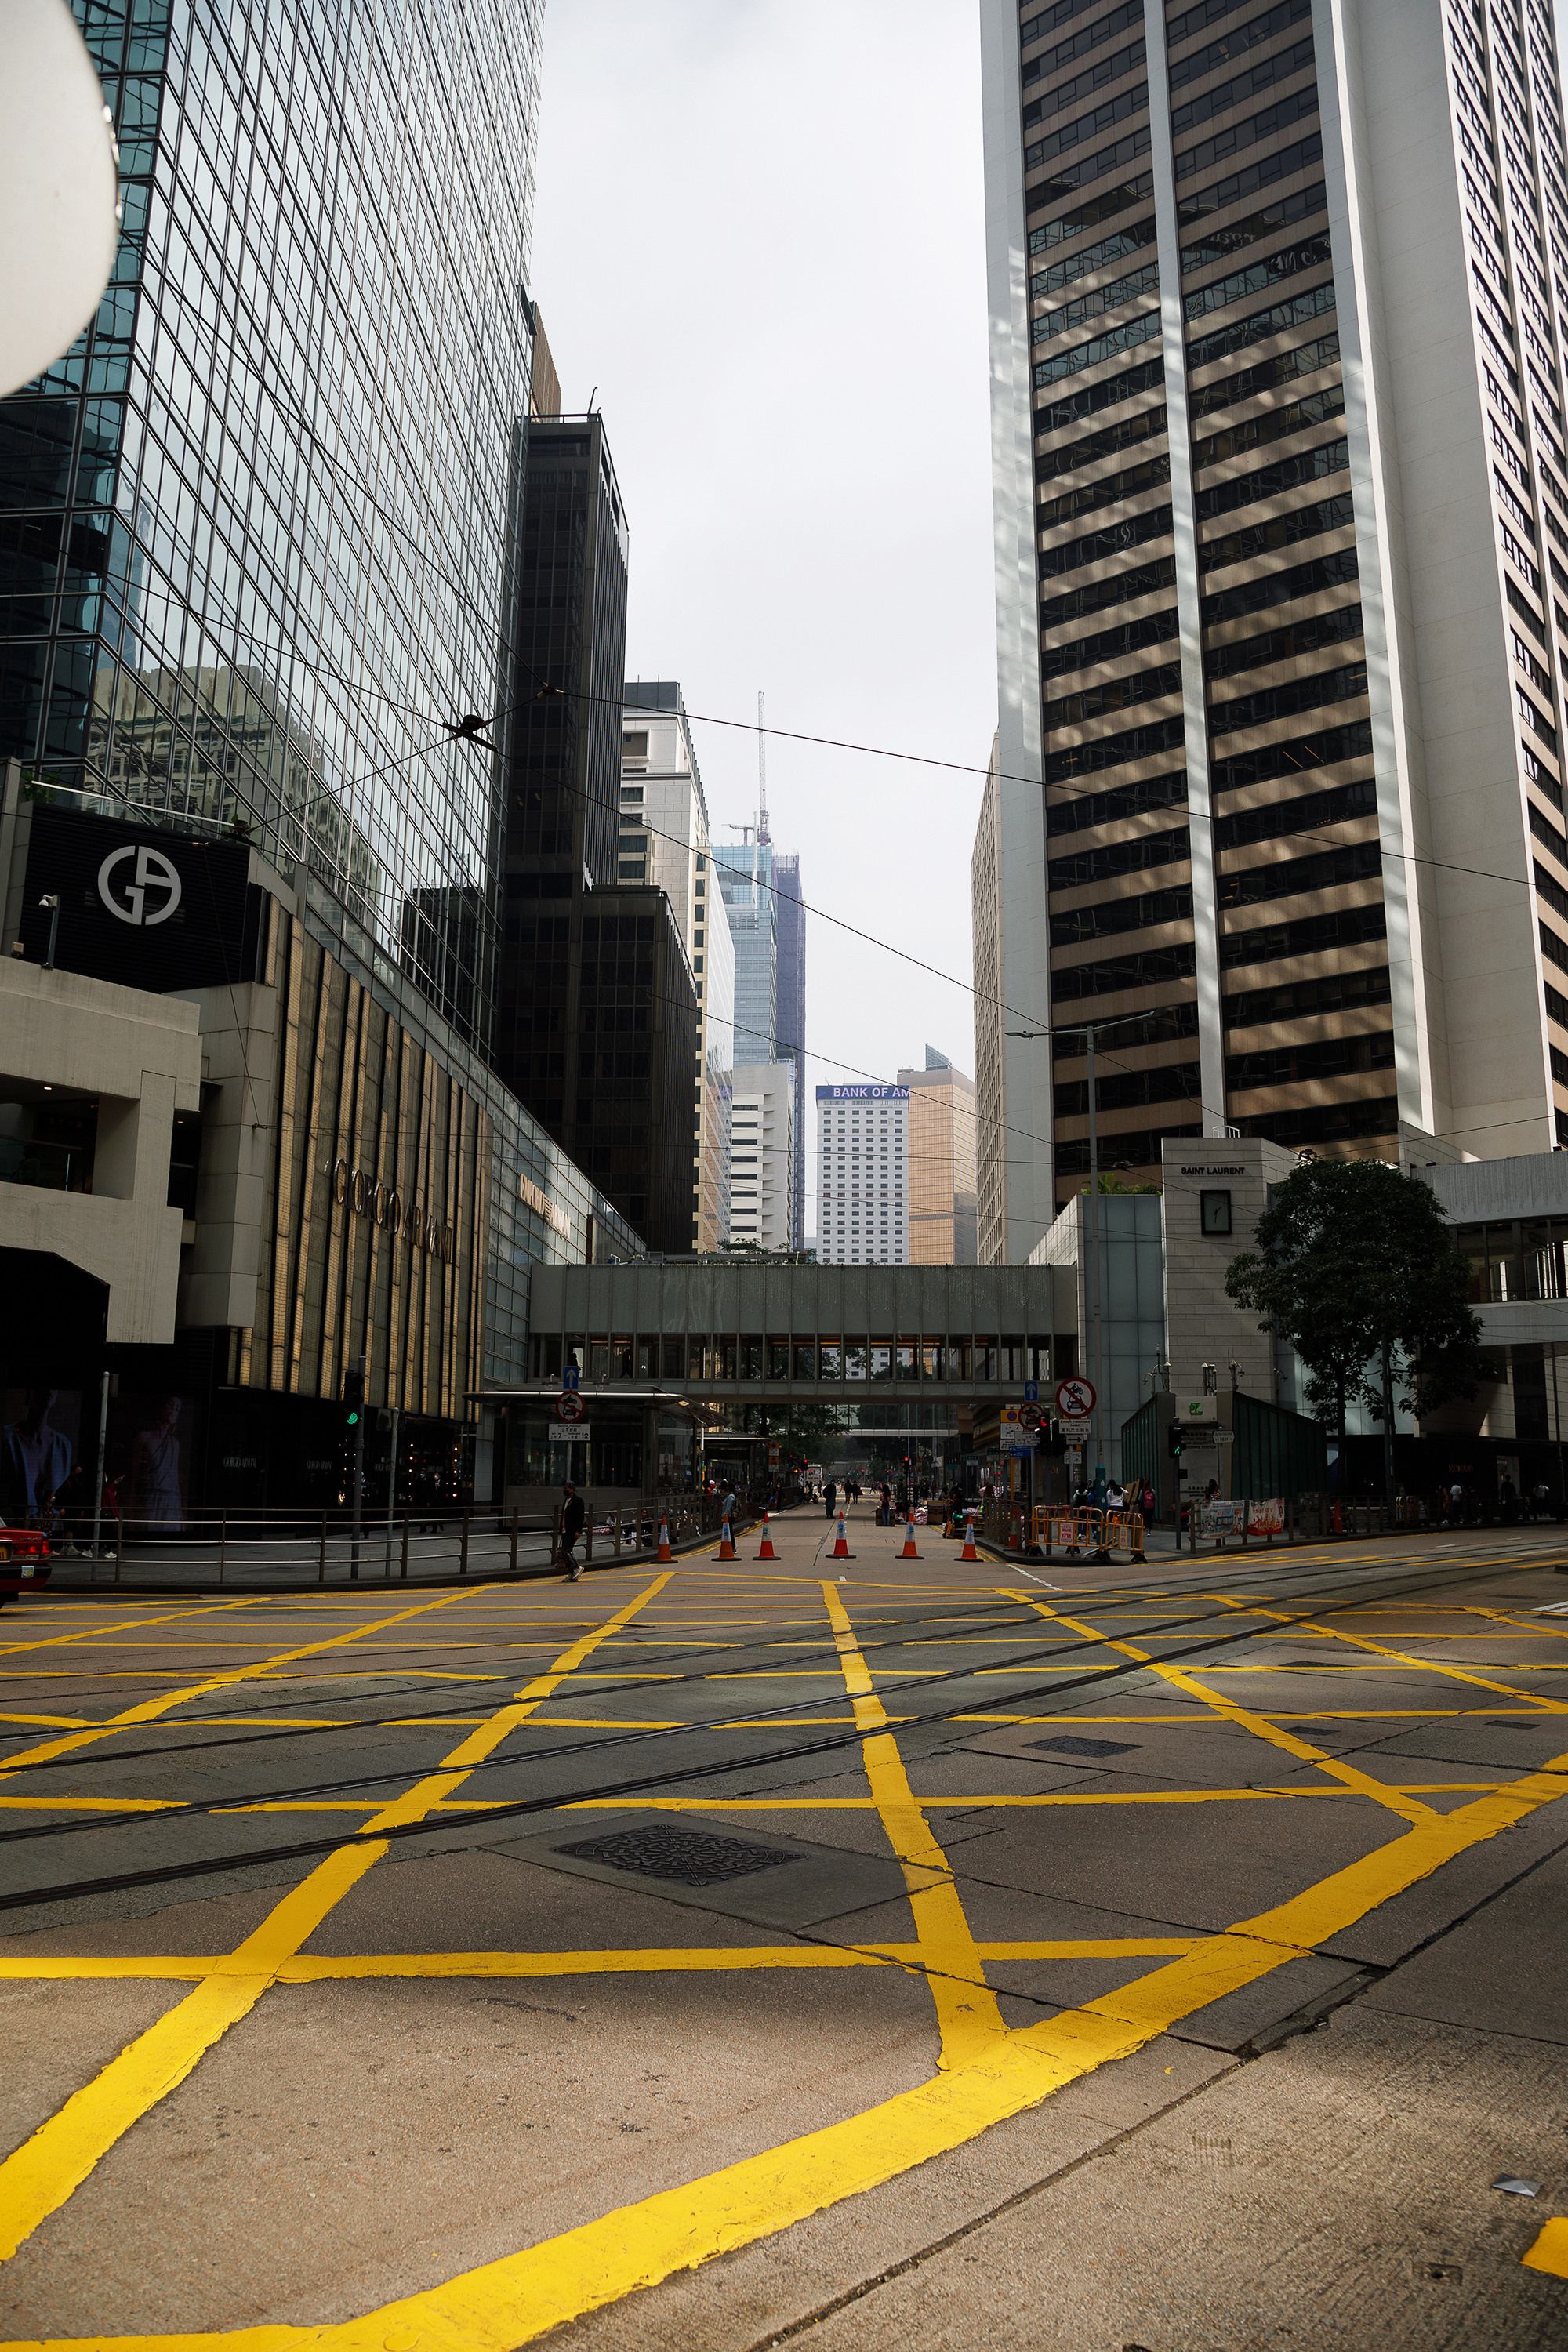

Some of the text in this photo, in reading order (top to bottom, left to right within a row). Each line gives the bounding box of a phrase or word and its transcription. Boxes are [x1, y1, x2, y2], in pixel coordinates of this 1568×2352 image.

[833, 1087, 868, 1098] BANK
[872, 1087, 888, 1098] OF
[333, 1159, 401, 1235] GIORGIO
